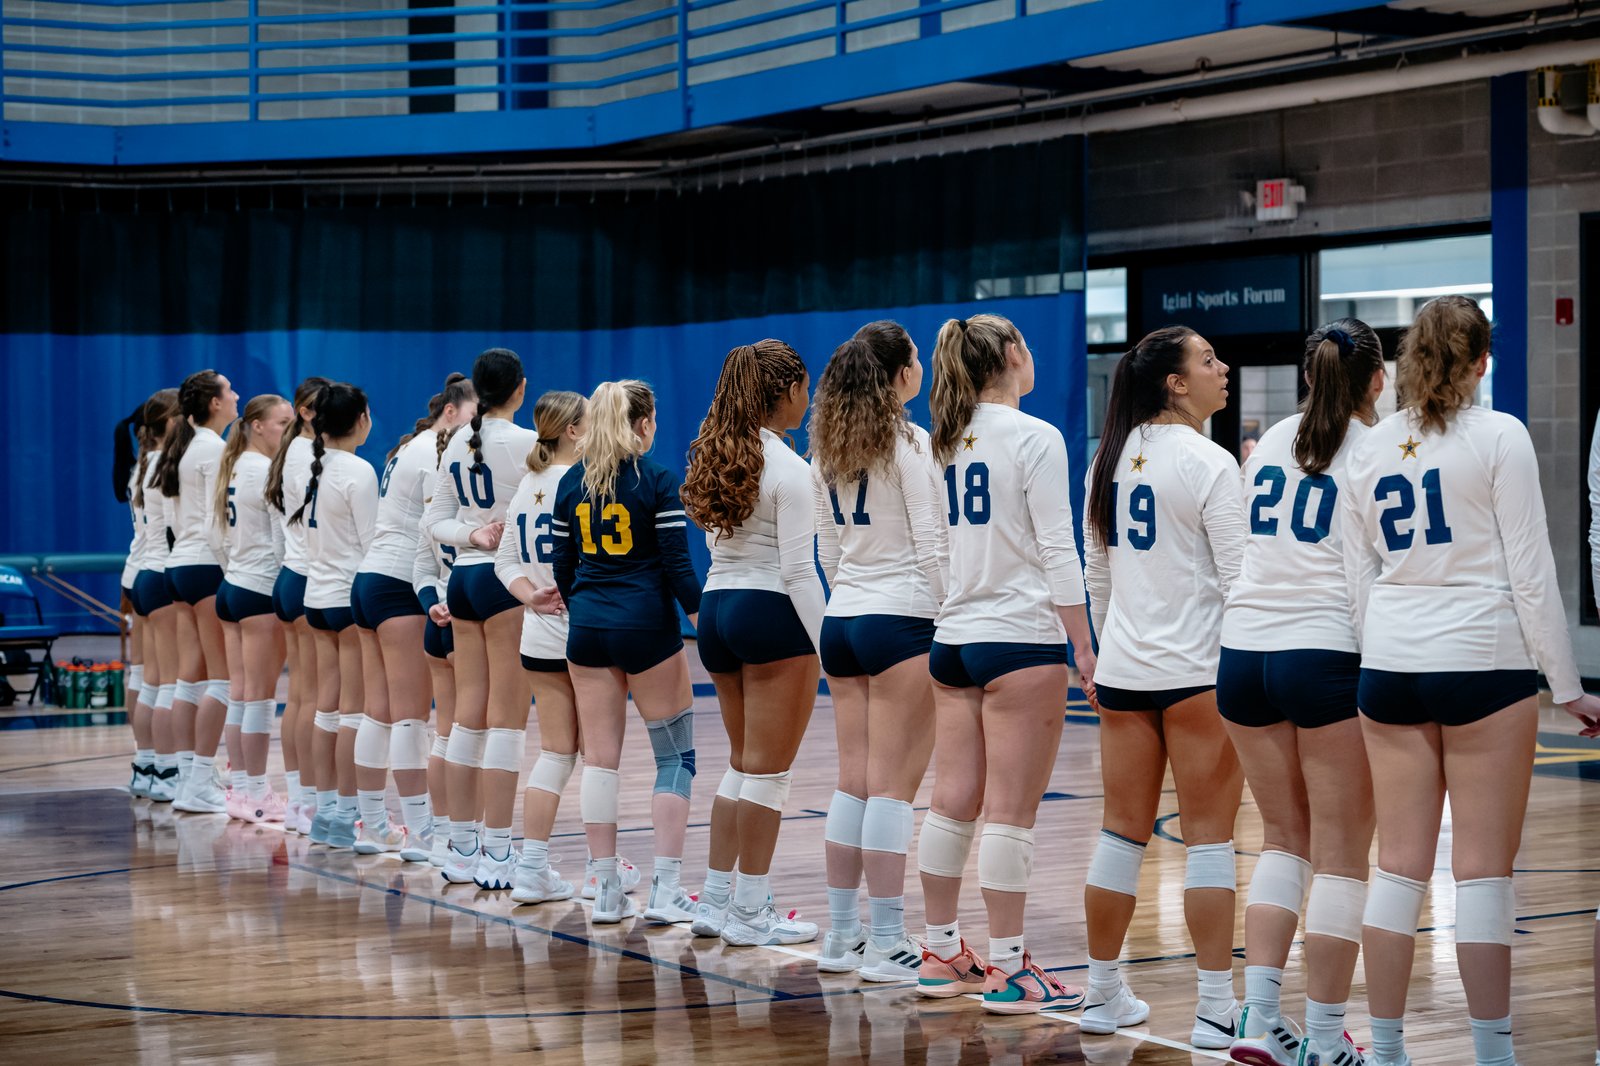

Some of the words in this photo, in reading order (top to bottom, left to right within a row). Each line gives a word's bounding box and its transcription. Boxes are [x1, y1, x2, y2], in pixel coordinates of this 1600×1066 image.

[1263, 182, 1284, 208] EXIT
[1162, 292, 1192, 313] Igini
[1196, 289, 1239, 311] Sports
[1243, 286, 1286, 305] Forum
[380, 456, 398, 497] 8
[449, 461, 495, 509] 10
[944, 461, 991, 526] 18
[575, 502, 634, 556] 13
[1250, 465, 1338, 544] 20
[1373, 467, 1453, 552] 21
[516, 513, 554, 564] 12
